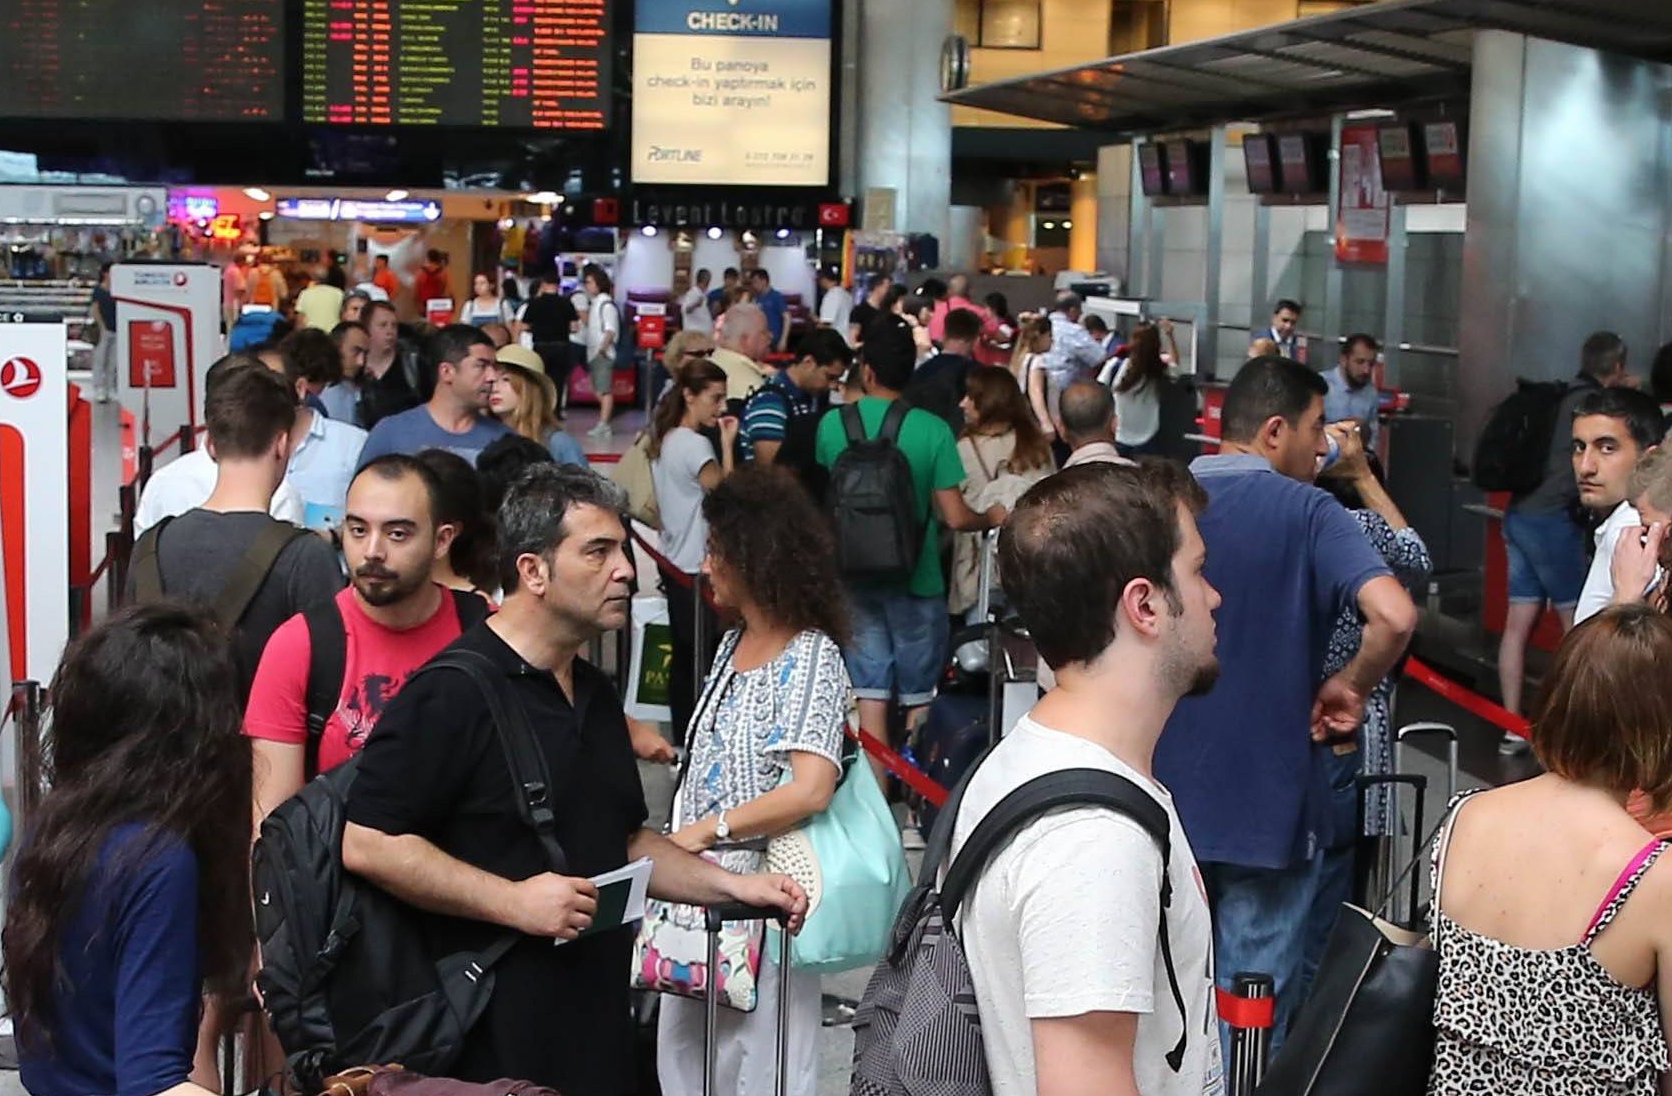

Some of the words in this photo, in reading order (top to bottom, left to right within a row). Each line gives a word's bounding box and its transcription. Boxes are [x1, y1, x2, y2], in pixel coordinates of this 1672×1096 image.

[687, 11, 778, 31] CHECK-IN
[691, 58, 712, 71] Bu
[716, 60, 769, 74] panoya
[647, 75, 709, 88] check-in
[693, 94, 718, 106] bizi
[633, 200, 711, 224] Levent
